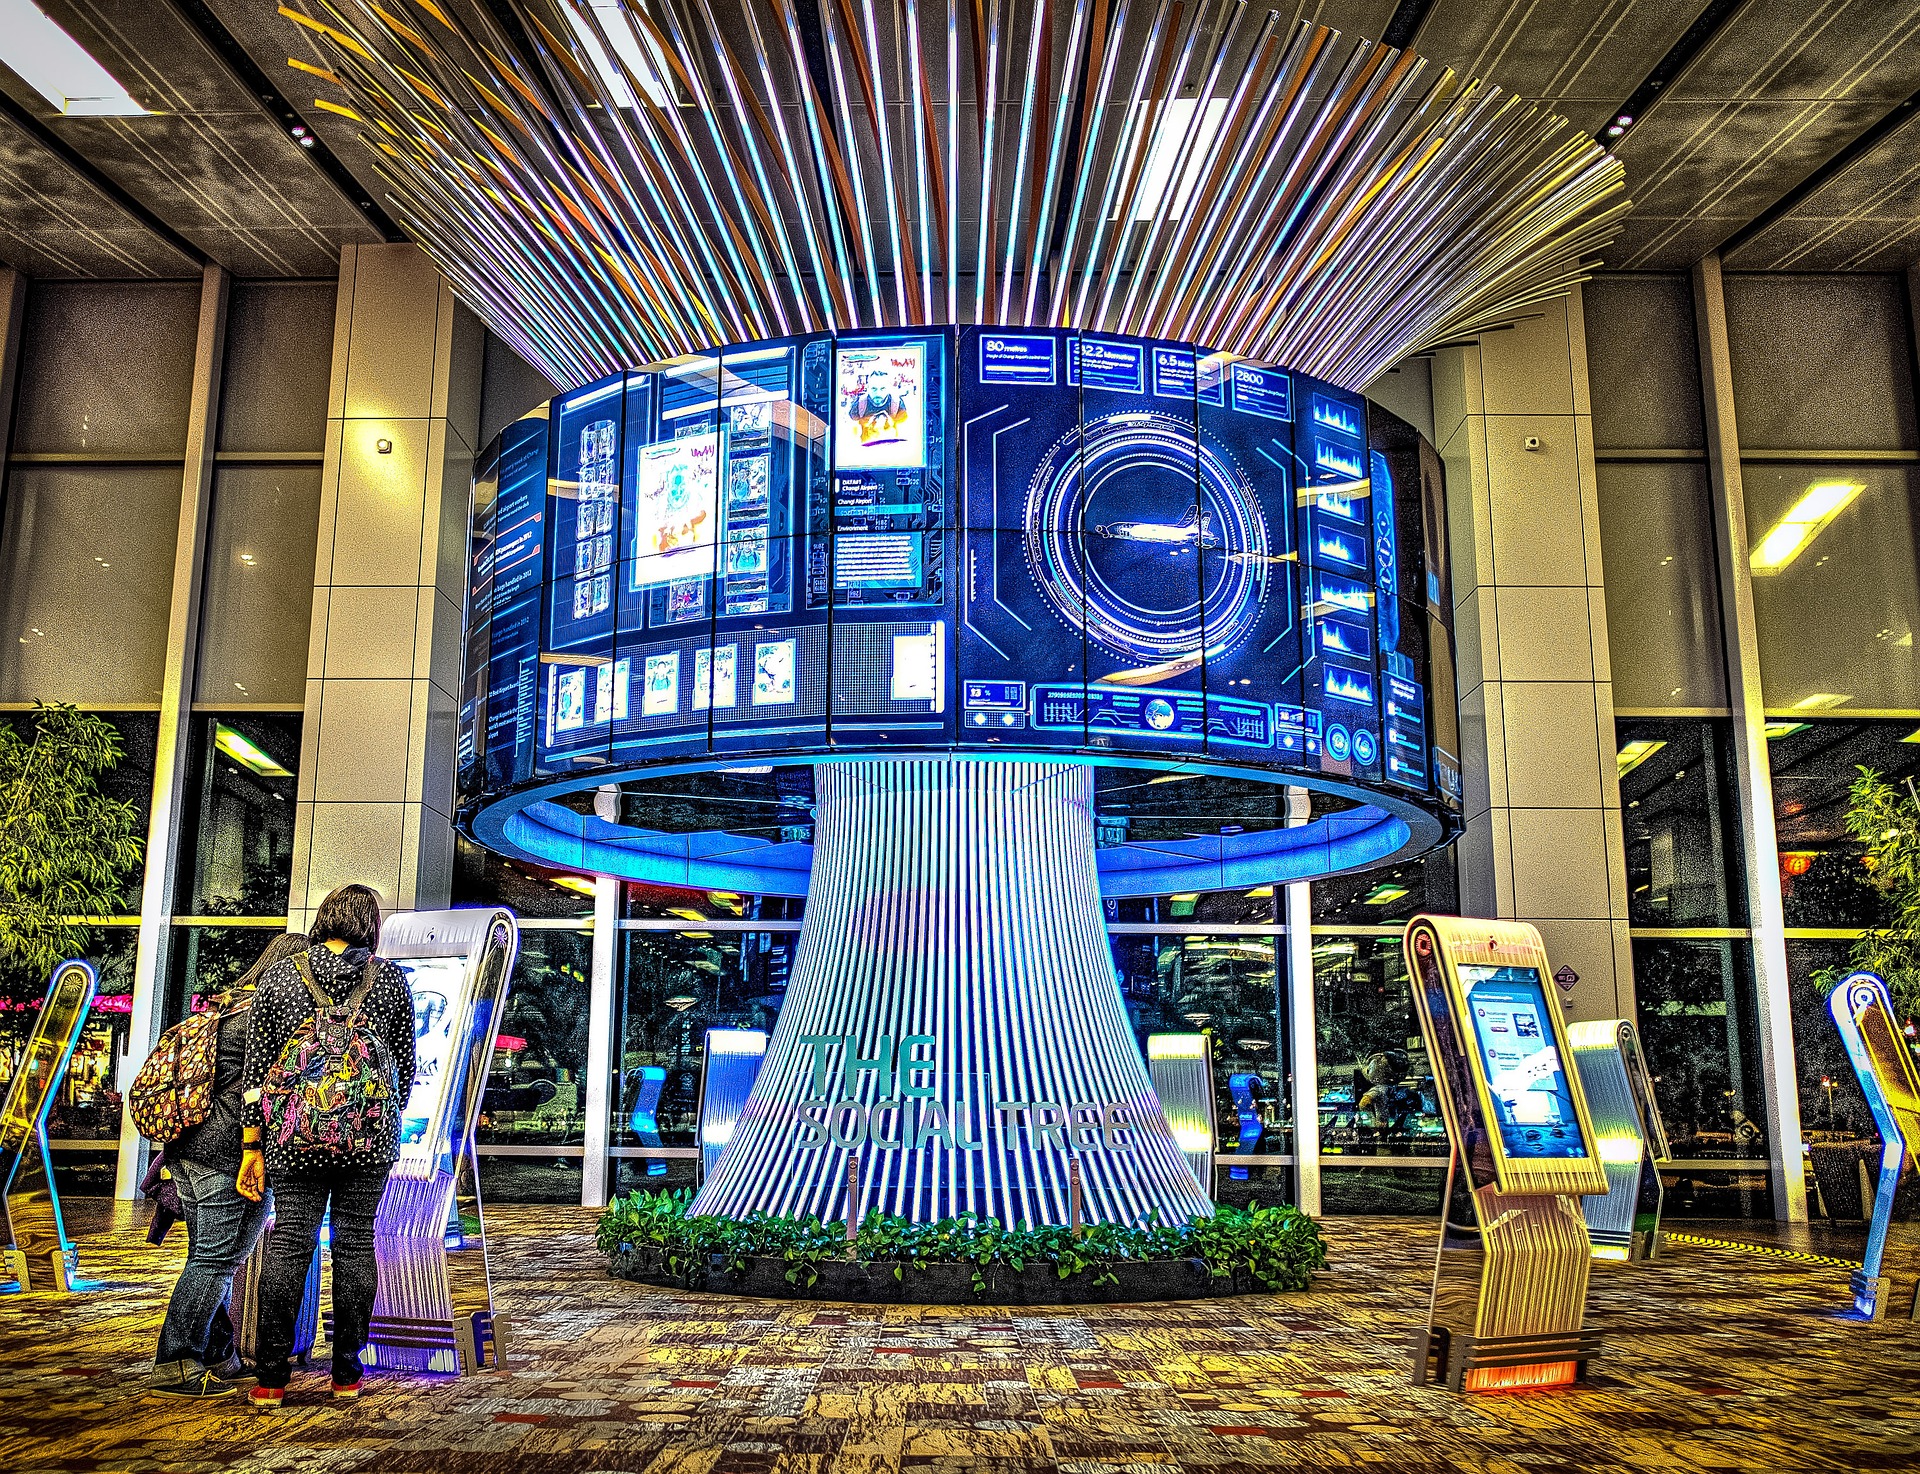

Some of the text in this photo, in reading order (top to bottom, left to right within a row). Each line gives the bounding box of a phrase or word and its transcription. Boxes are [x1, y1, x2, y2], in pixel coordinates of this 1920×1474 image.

[986, 340, 1004, 352] 80
[1158, 354, 1178, 367] 6.5
[1236, 370, 1264, 385] 2800
[837, 523, 869, 531] Environment
[800, 1034, 936, 1097] THE
[799, 1101, 1132, 1150] SOCIAL TREE
